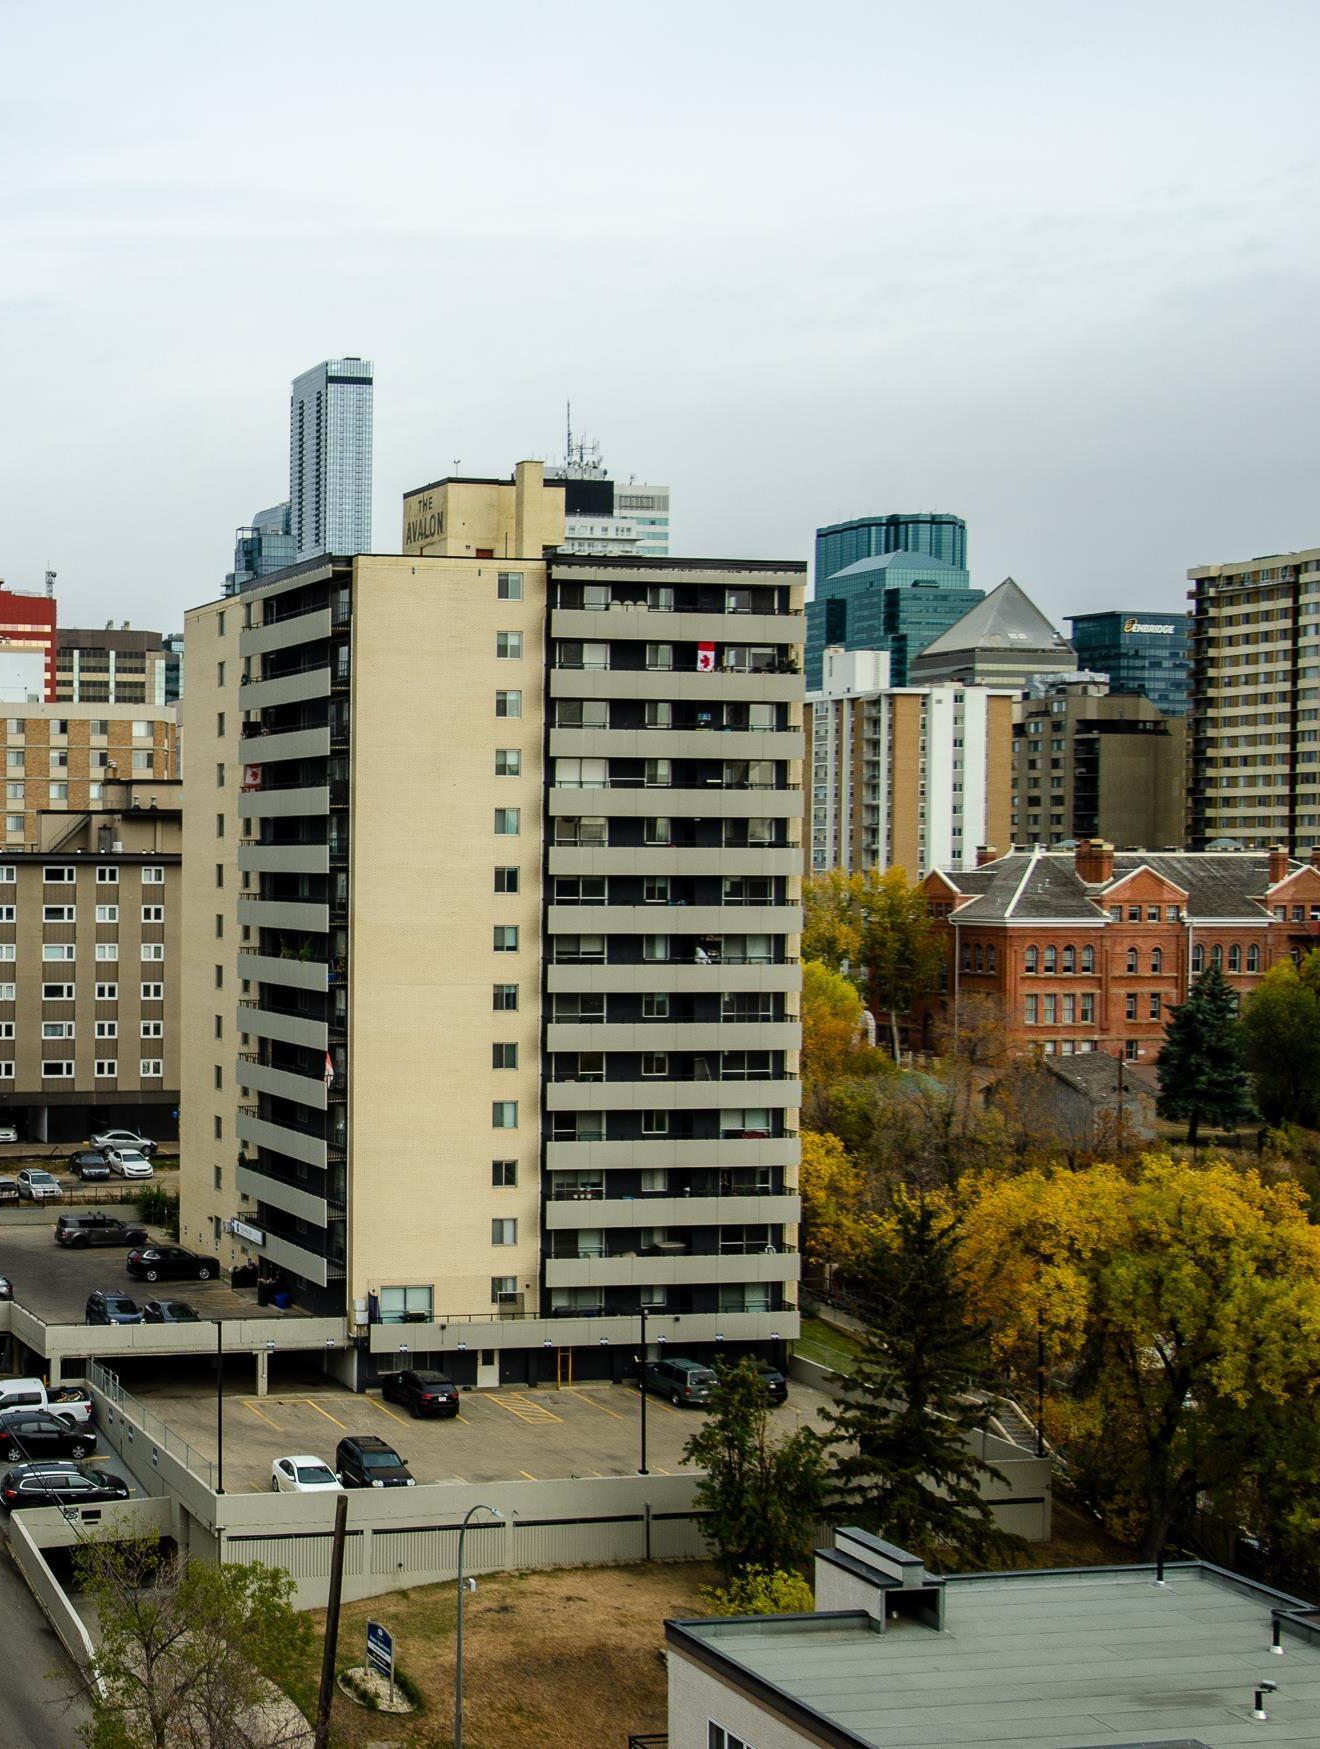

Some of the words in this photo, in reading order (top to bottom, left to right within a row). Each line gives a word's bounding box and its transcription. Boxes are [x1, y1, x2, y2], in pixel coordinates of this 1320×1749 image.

[418, 496, 433, 512] THE
[406, 511, 444, 545] AVALON
[1131, 623, 1175, 634] ENBRIDGE
